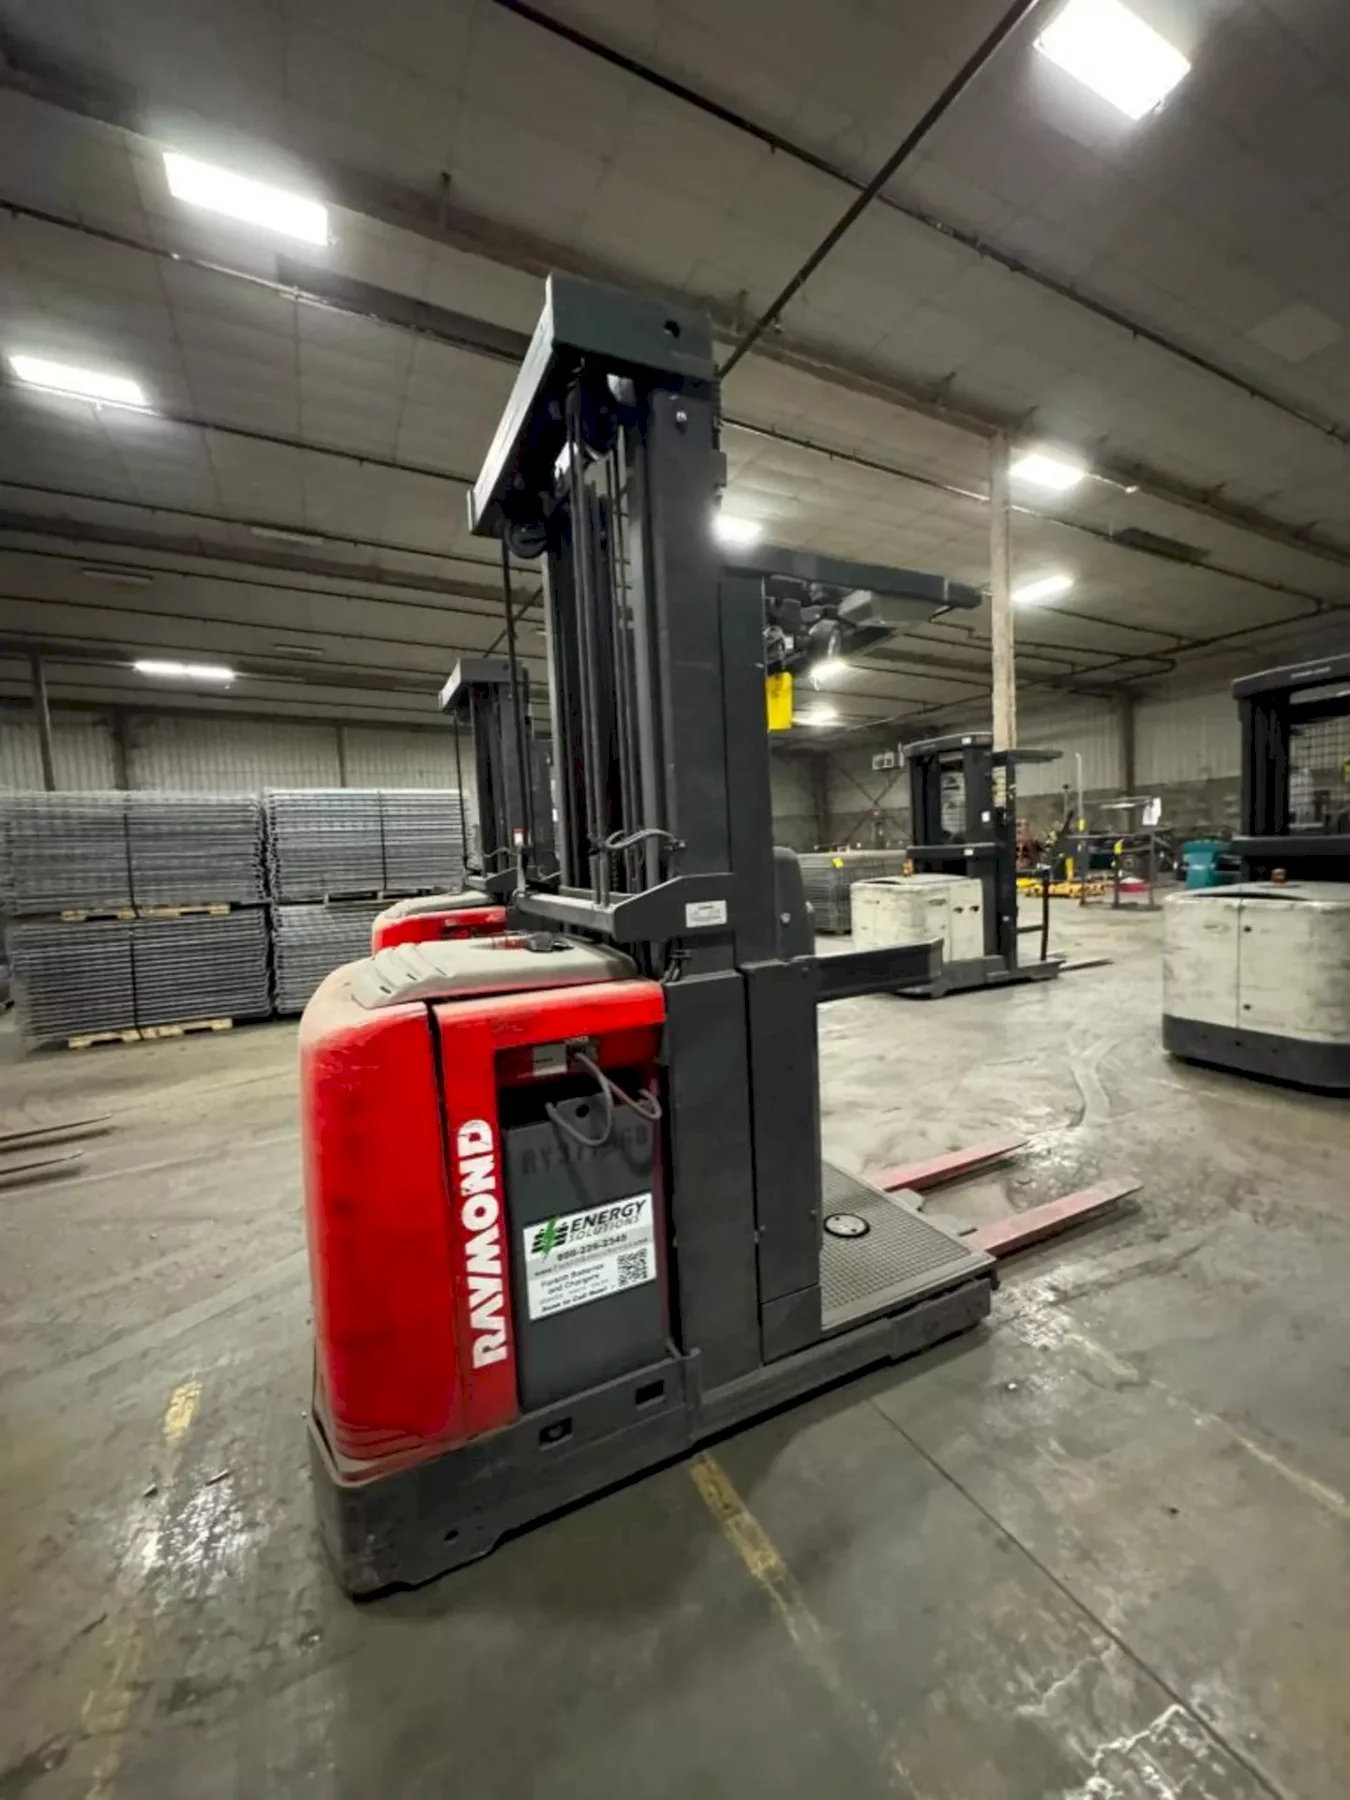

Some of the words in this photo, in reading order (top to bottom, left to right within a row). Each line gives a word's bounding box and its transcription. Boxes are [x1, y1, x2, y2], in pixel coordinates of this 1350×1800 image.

[568, 1215, 639, 1243] SOLUTIONS
[571, 1199, 646, 1232] ENERGY
[457, 1119, 507, 1369] RAYMOND
